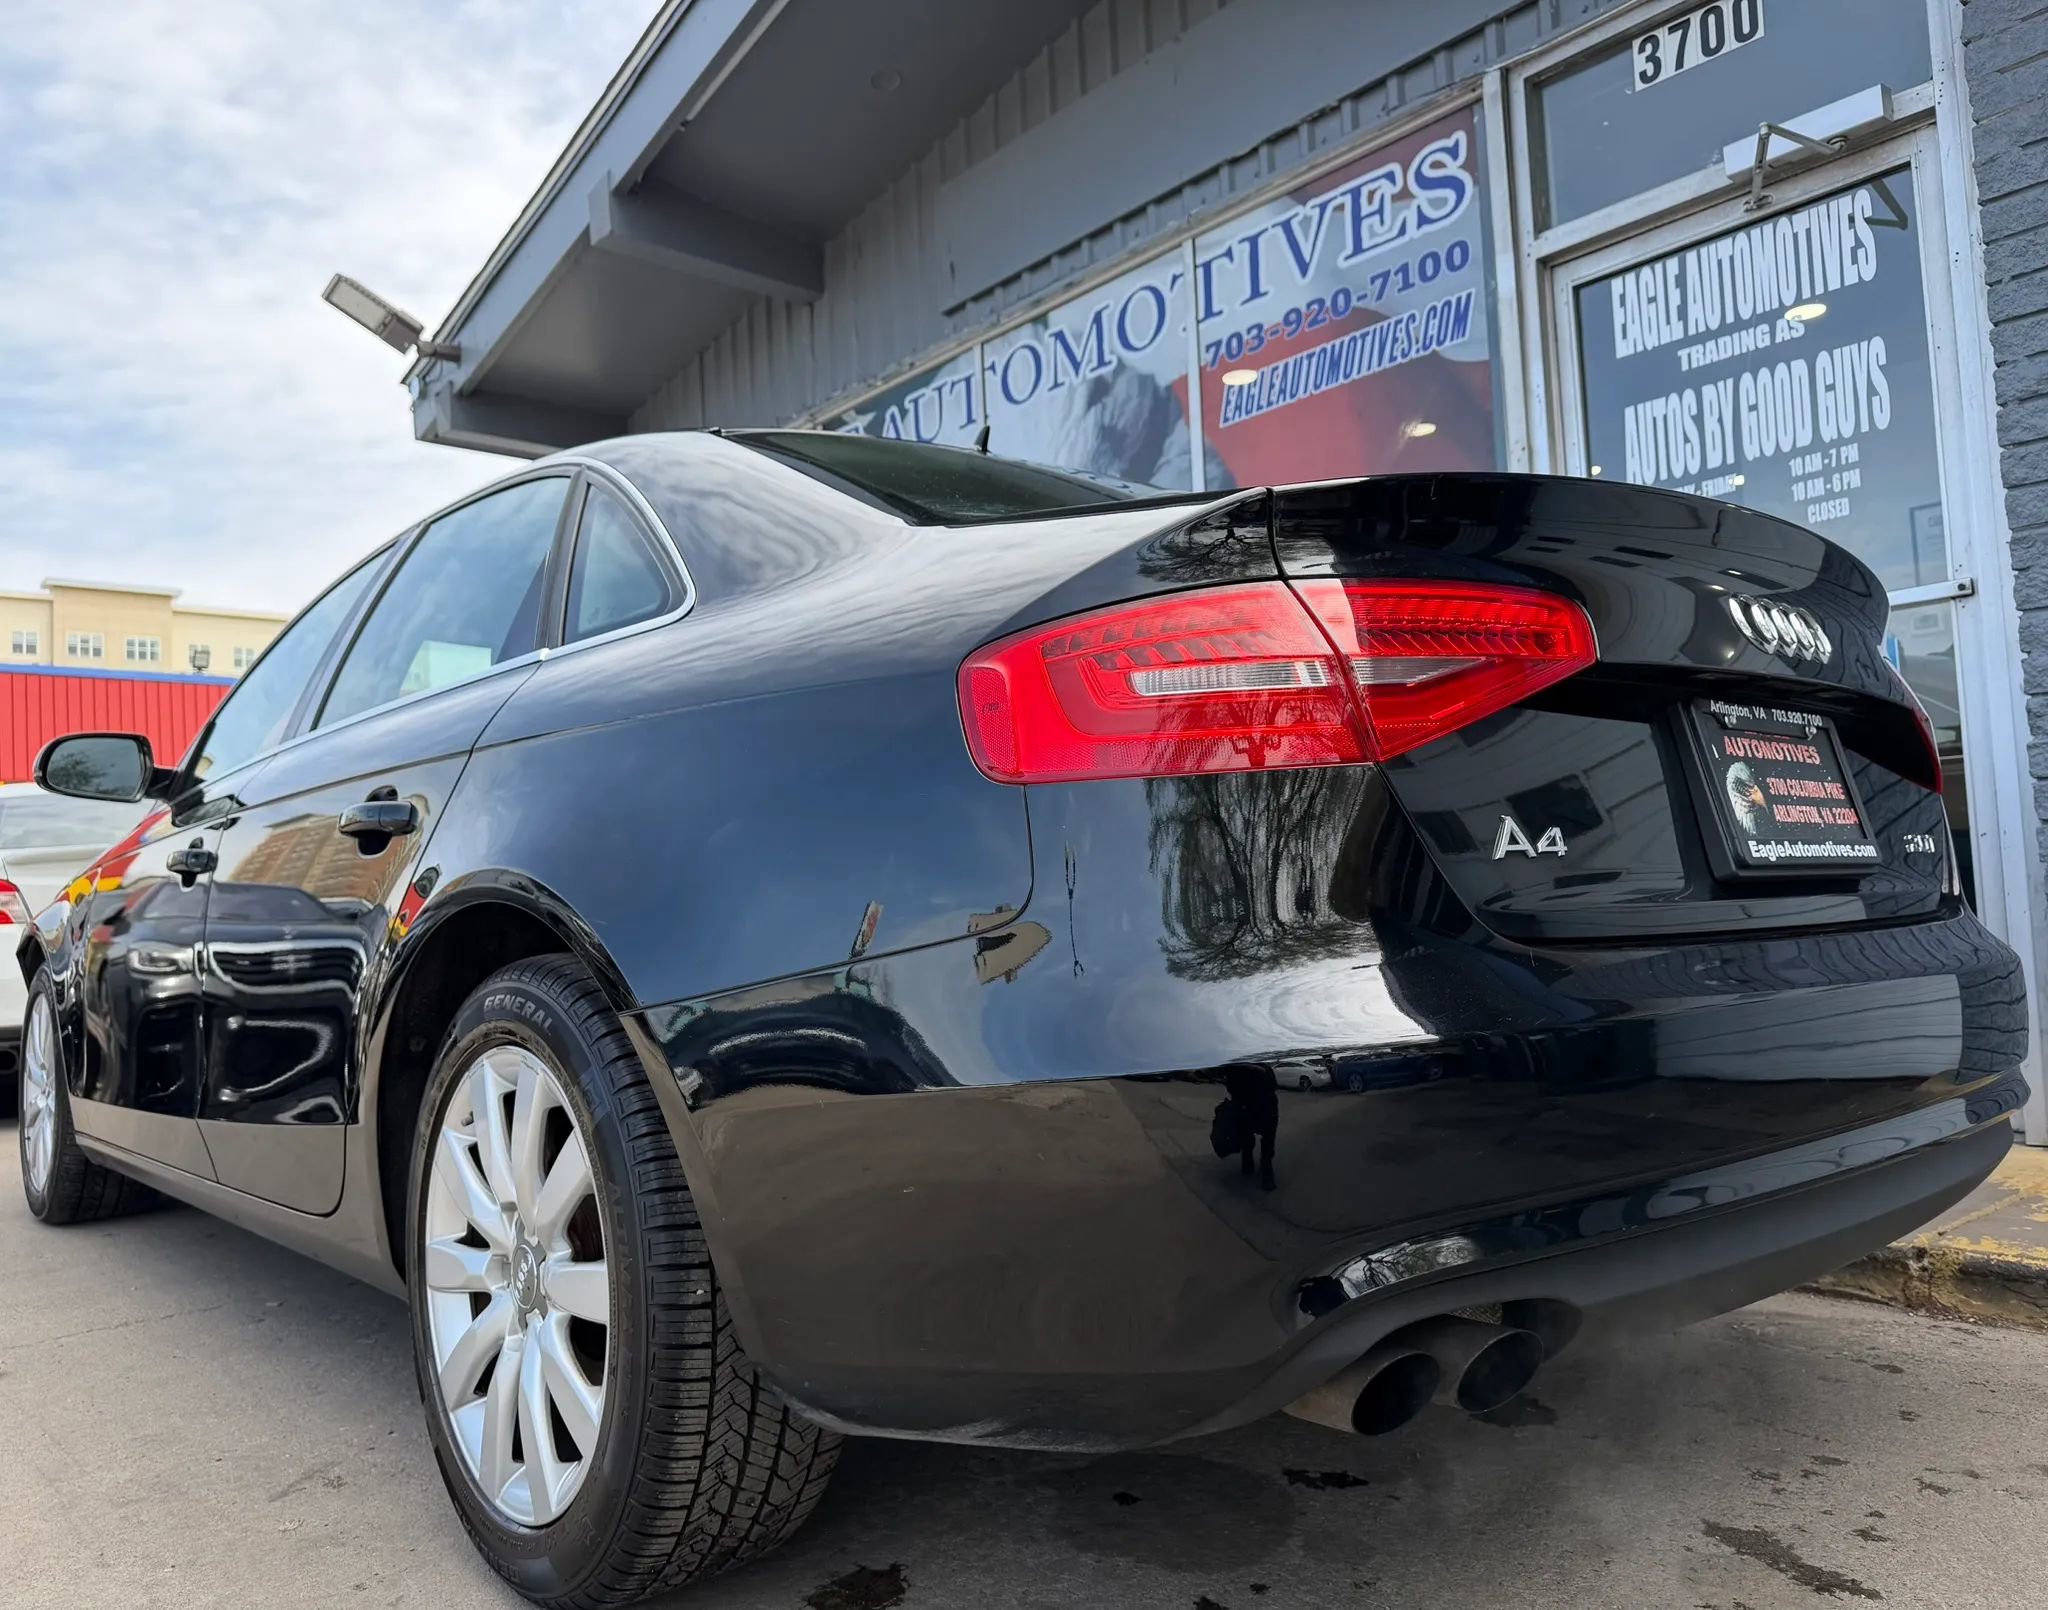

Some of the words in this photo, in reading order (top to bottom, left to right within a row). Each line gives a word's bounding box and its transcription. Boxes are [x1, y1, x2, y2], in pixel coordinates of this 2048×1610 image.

[1637, 0, 1760, 85] 3700
[1610, 256, 1685, 359] EAGLE
[1685, 188, 1877, 336] AUTOMOTIVES
[1205, 239, 1471, 369] 703-920-7100
[1220, 288, 1475, 428] EAGLEAUTOMOTIVES.COM
[1677, 322, 1772, 372] TRADING
[1775, 316, 1806, 344] AS
[1624, 388, 1701, 486] AUTOS
[1701, 377, 1735, 470] BY
[1738, 358, 1813, 462] GOOD
[1815, 336, 1891, 443] GUYS
[1788, 456, 1804, 477] 10
[1804, 452, 1823, 474] AM
[1829, 447, 1837, 468] 7
[1840, 442, 1859, 465] PM
[1791, 481, 1806, 502] 10
[1806, 477, 1825, 499] AM
[1832, 473, 1842, 493] 6
[1842, 468, 1861, 491] PM
[1807, 497, 1850, 524] CLOSED
[1710, 699, 1753, 720] Arlington,
[1752, 706, 1767, 720] VA
[1771, 708, 1823, 727] 703.920.7100
[1723, 735, 1821, 765] AUTOMOTIVES
[1492, 814, 1568, 860] A4
[1748, 840, 1877, 862] EagleAutomotives.com
[483, 995, 553, 1036] GENERAL
